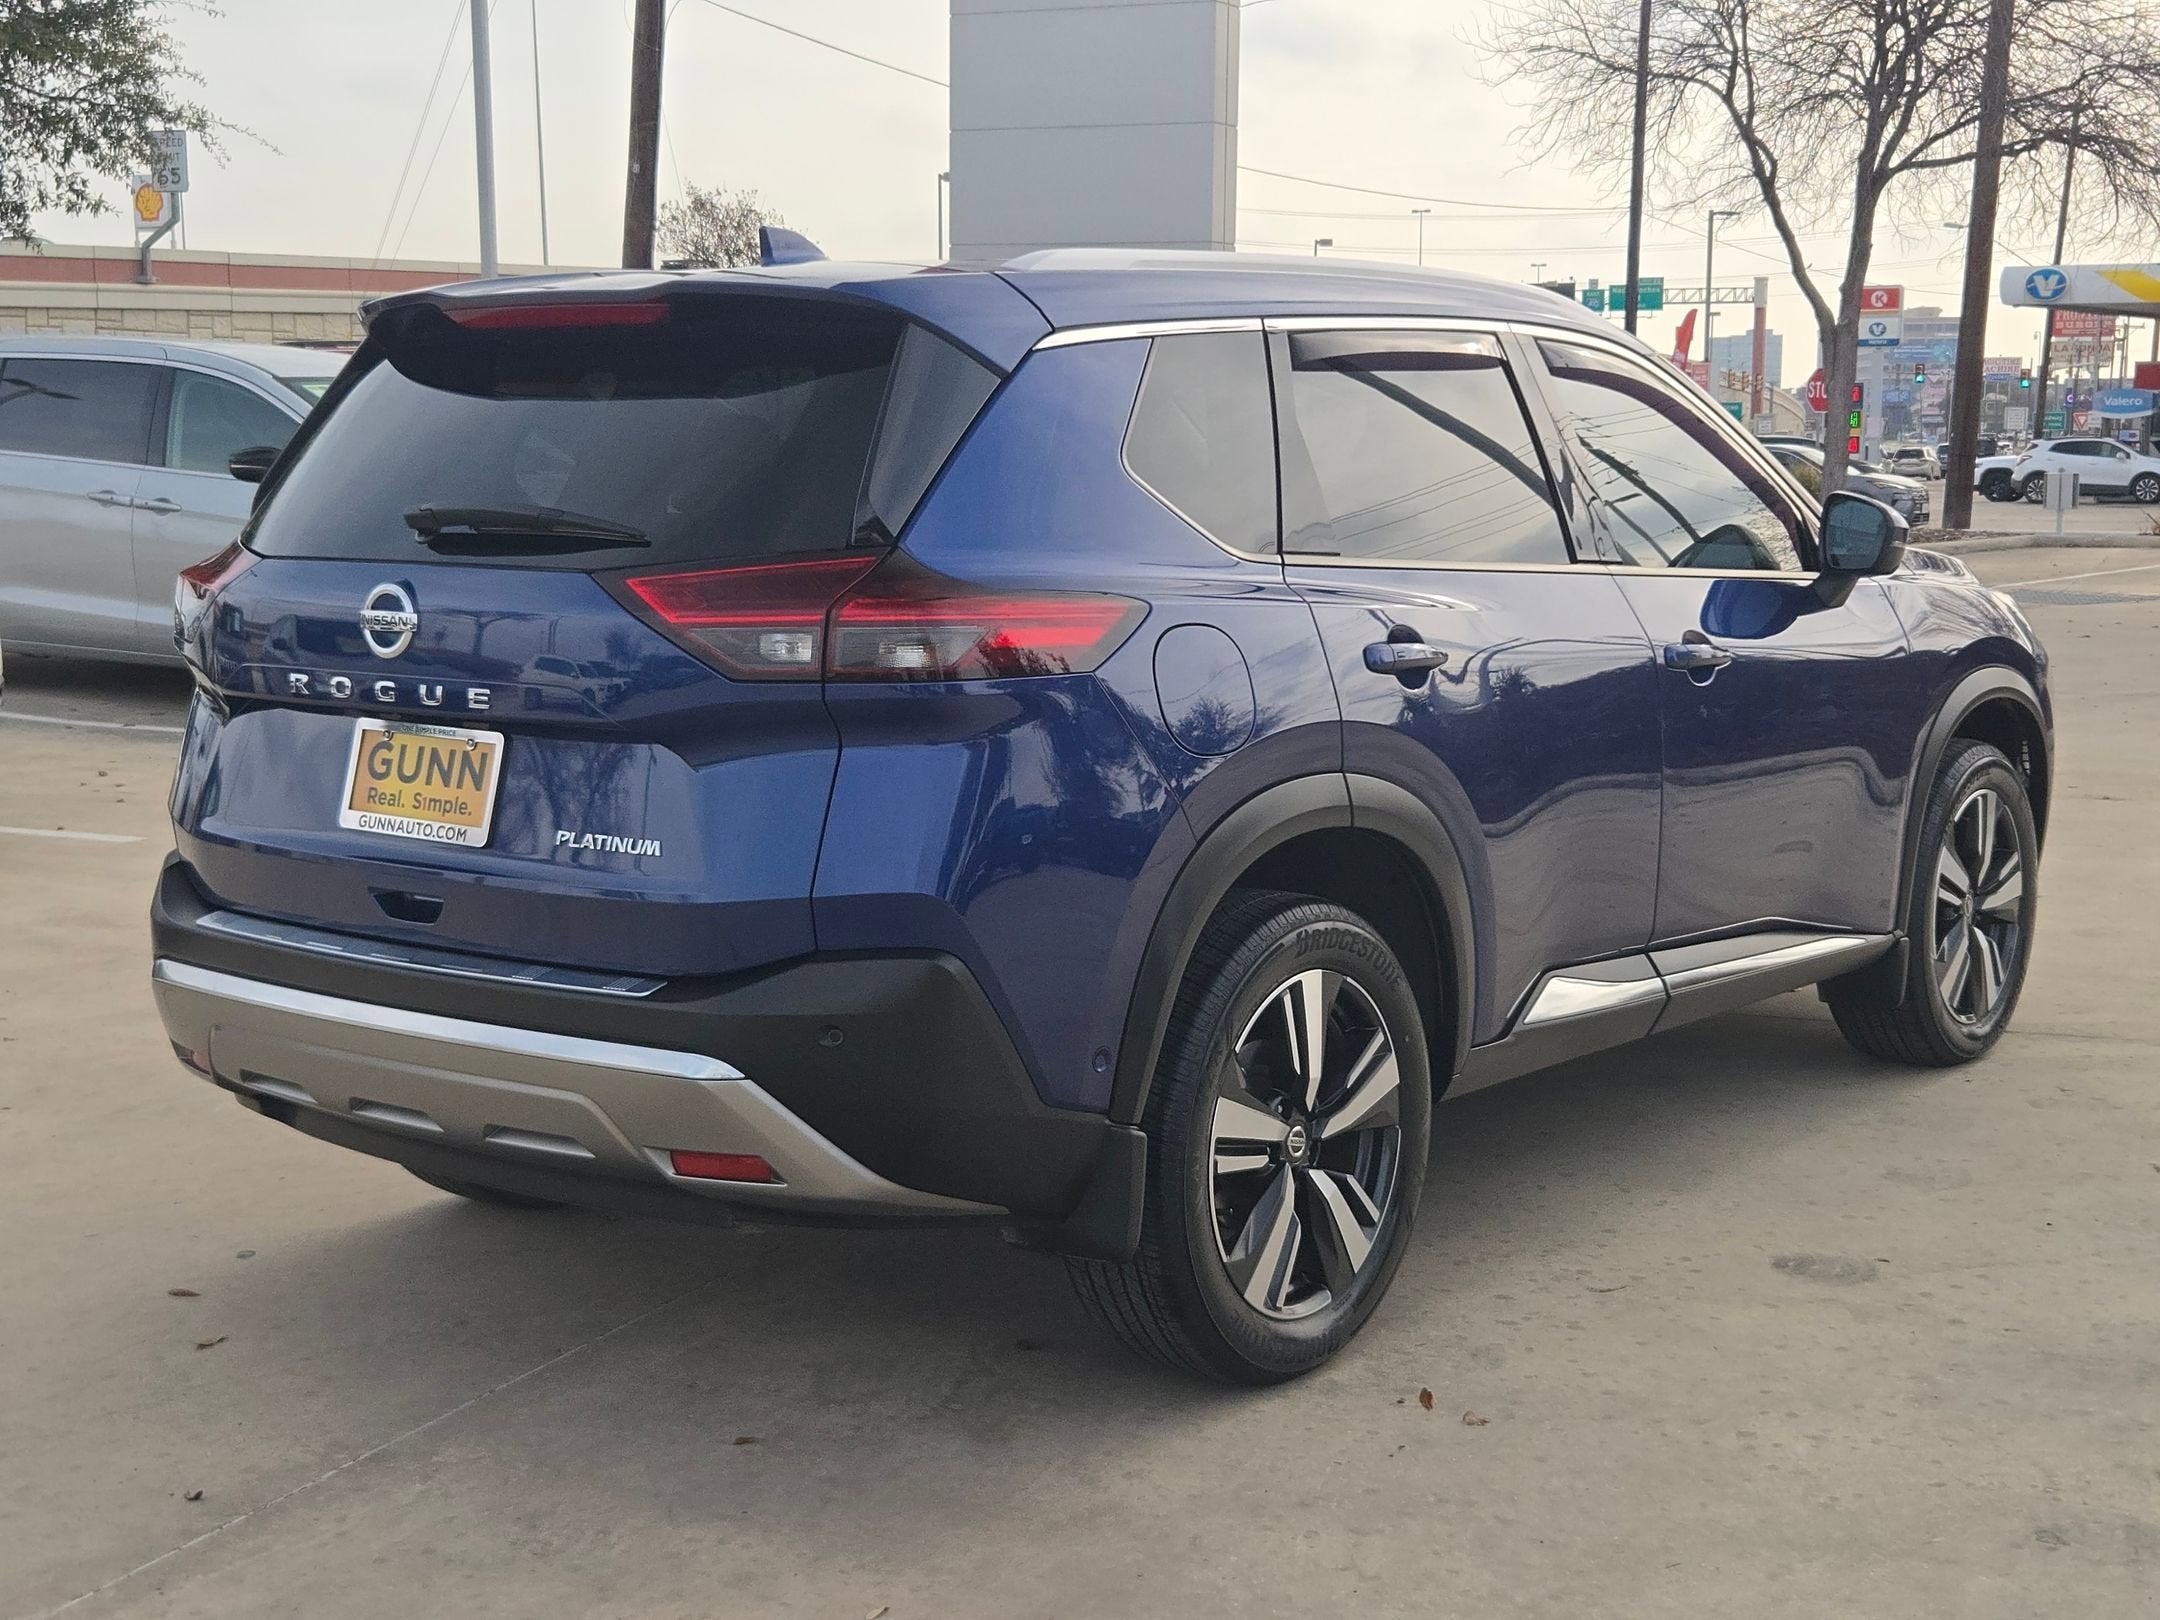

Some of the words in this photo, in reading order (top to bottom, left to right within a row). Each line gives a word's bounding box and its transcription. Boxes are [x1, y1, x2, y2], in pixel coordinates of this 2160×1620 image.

[157, 168, 181, 186] 65
[1984, 365, 2019, 373] ACHINE
[1808, 381, 1827, 399] STO
[2103, 396, 2143, 406] Valero
[361, 613, 409, 628] NISSAN
[288, 672, 491, 710] ROGUE
[367, 741, 489, 792] GUNN
[367, 787, 405, 809] Real.
[358, 815, 469, 843] GUNNAUTO.COM
[555, 829, 662, 858] PLATINUM
